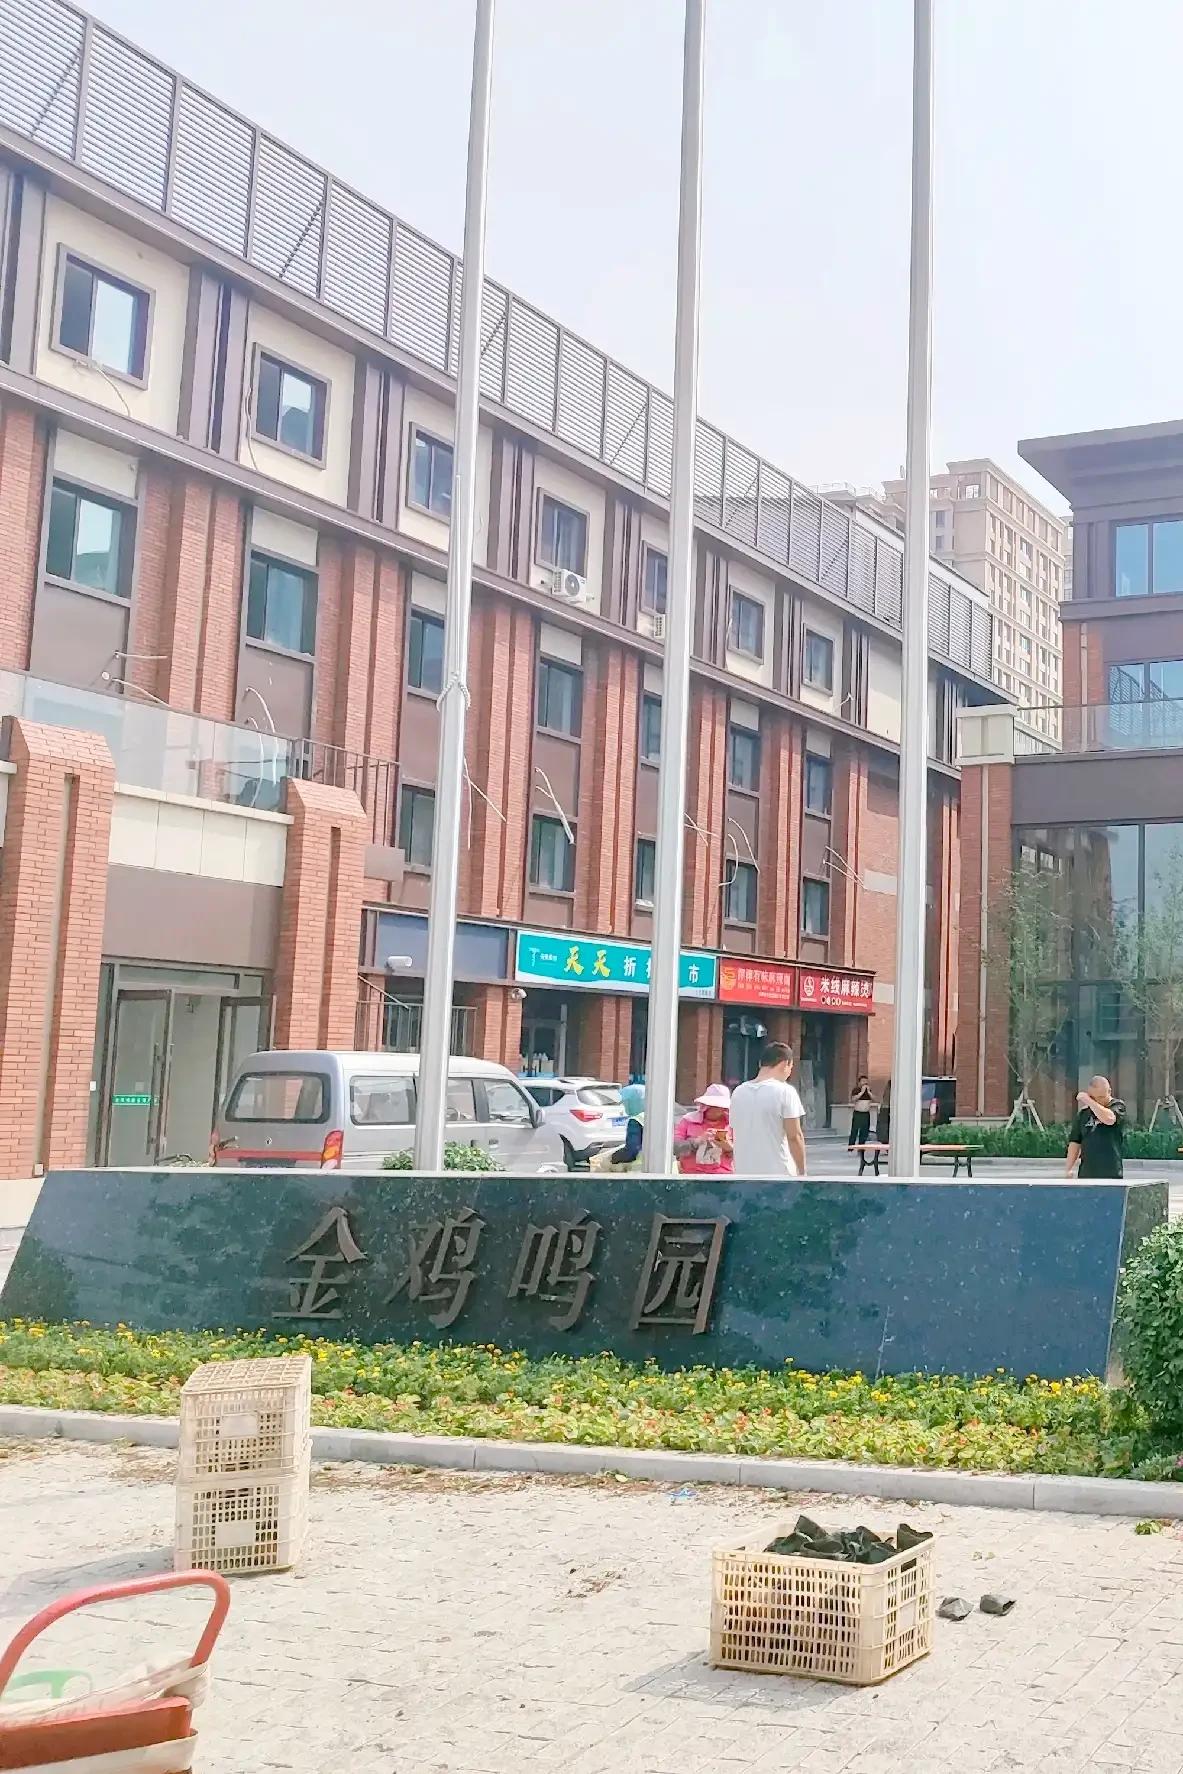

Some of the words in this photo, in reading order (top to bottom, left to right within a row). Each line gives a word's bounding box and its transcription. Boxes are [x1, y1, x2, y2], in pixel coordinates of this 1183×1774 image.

[563, 945, 700, 983] 天天折市
[820, 974, 871, 998] 米线麻辣烫
[271, 1204, 733, 1336] 金鸡鸣园
